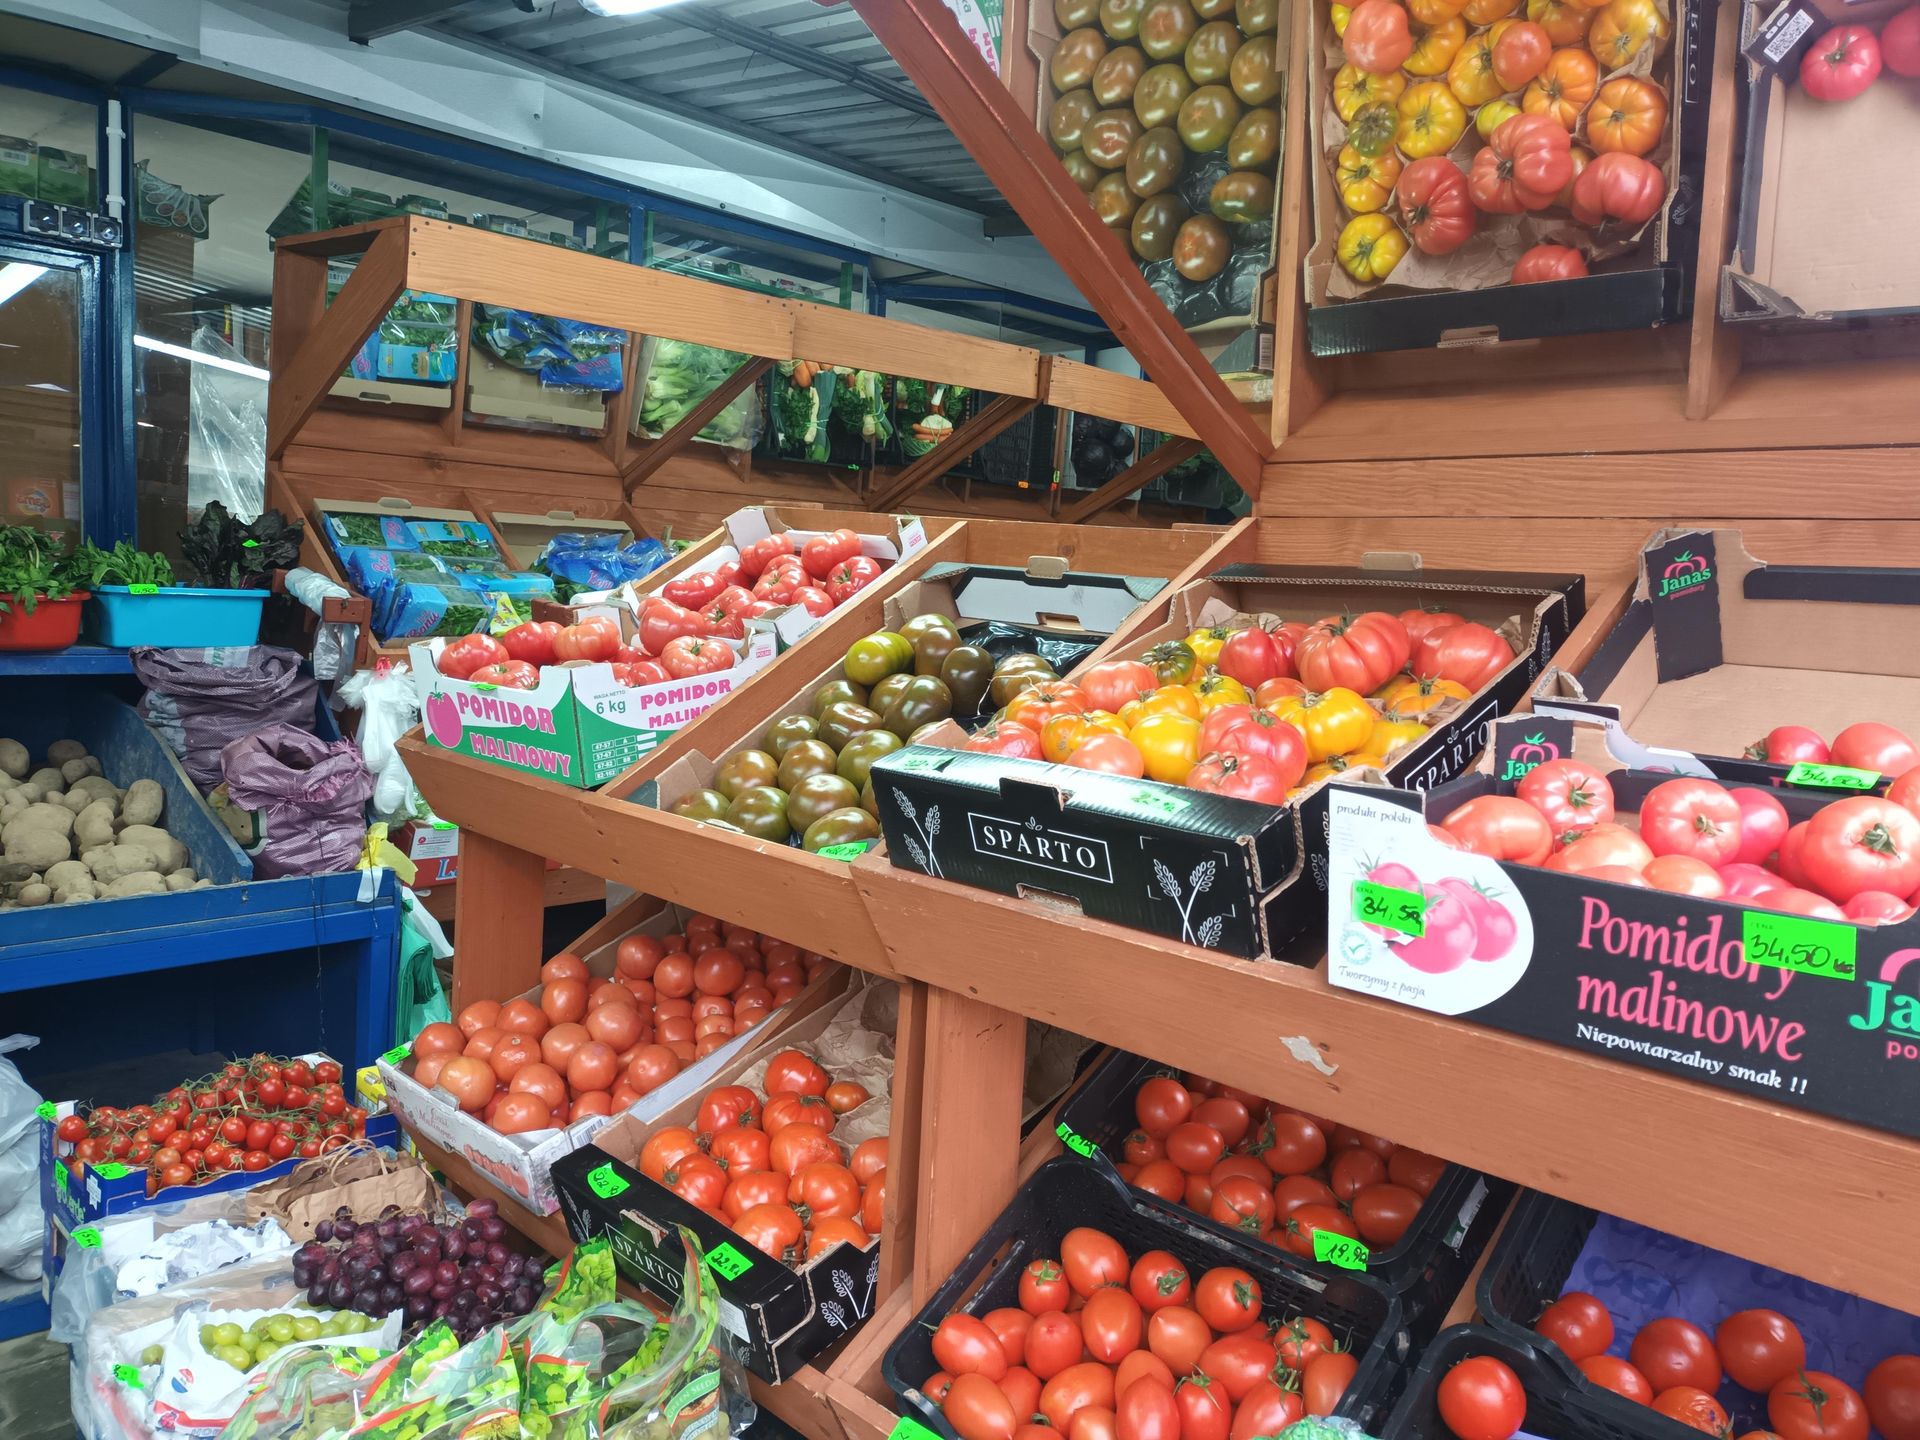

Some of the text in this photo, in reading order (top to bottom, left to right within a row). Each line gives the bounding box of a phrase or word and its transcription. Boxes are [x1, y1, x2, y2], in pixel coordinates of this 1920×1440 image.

[1659, 568, 1711, 597] Janas
[456, 691, 556, 734] POMIDOR
[596, 699, 626, 715] 6 kg
[640, 678, 731, 710] POMIDOR
[469, 731, 570, 777] MALINOWY
[1415, 720, 1489, 793] SPARTO
[1336, 805, 1412, 824] produkt polski
[983, 825, 1096, 869] SPARTO
[1576, 970, 1807, 1062] malinowe
[1575, 1022, 1724, 1076] Niepowtarzalny
[1727, 1060, 1782, 1091] smak
[614, 1234, 679, 1290] SPARTO
